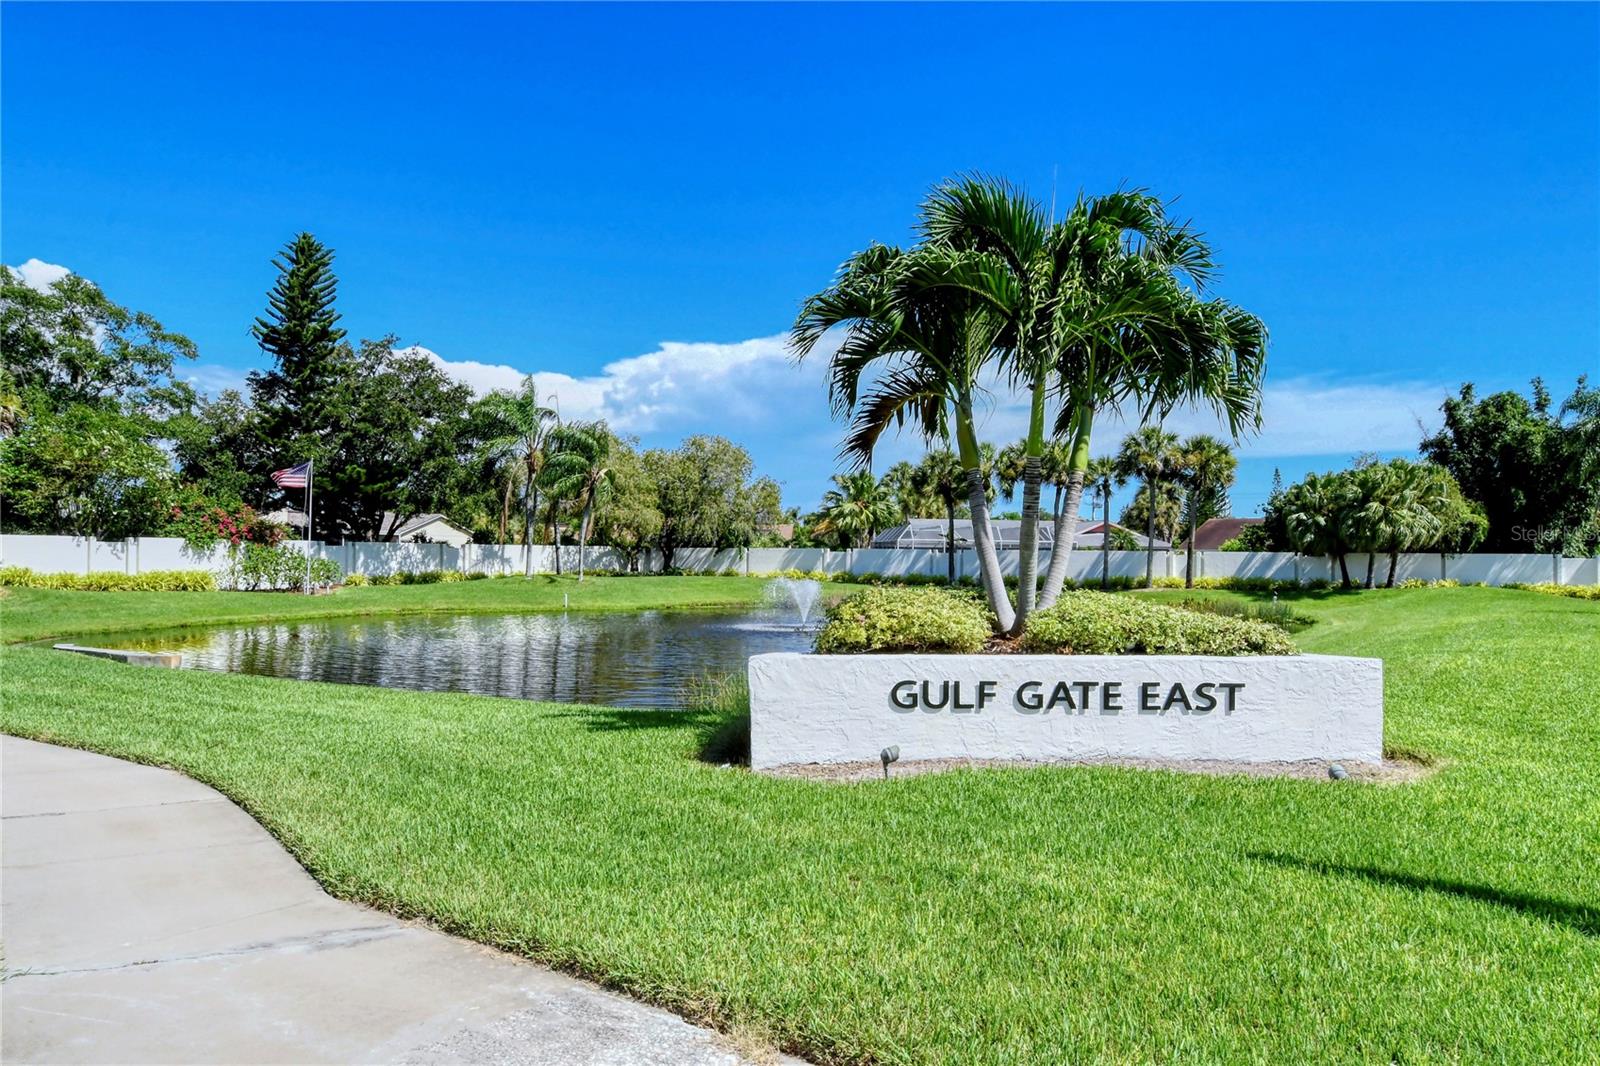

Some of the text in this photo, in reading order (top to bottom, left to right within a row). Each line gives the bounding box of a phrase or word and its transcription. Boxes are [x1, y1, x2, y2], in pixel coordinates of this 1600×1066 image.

[891, 680, 1246, 712] GULF GATE EAST
